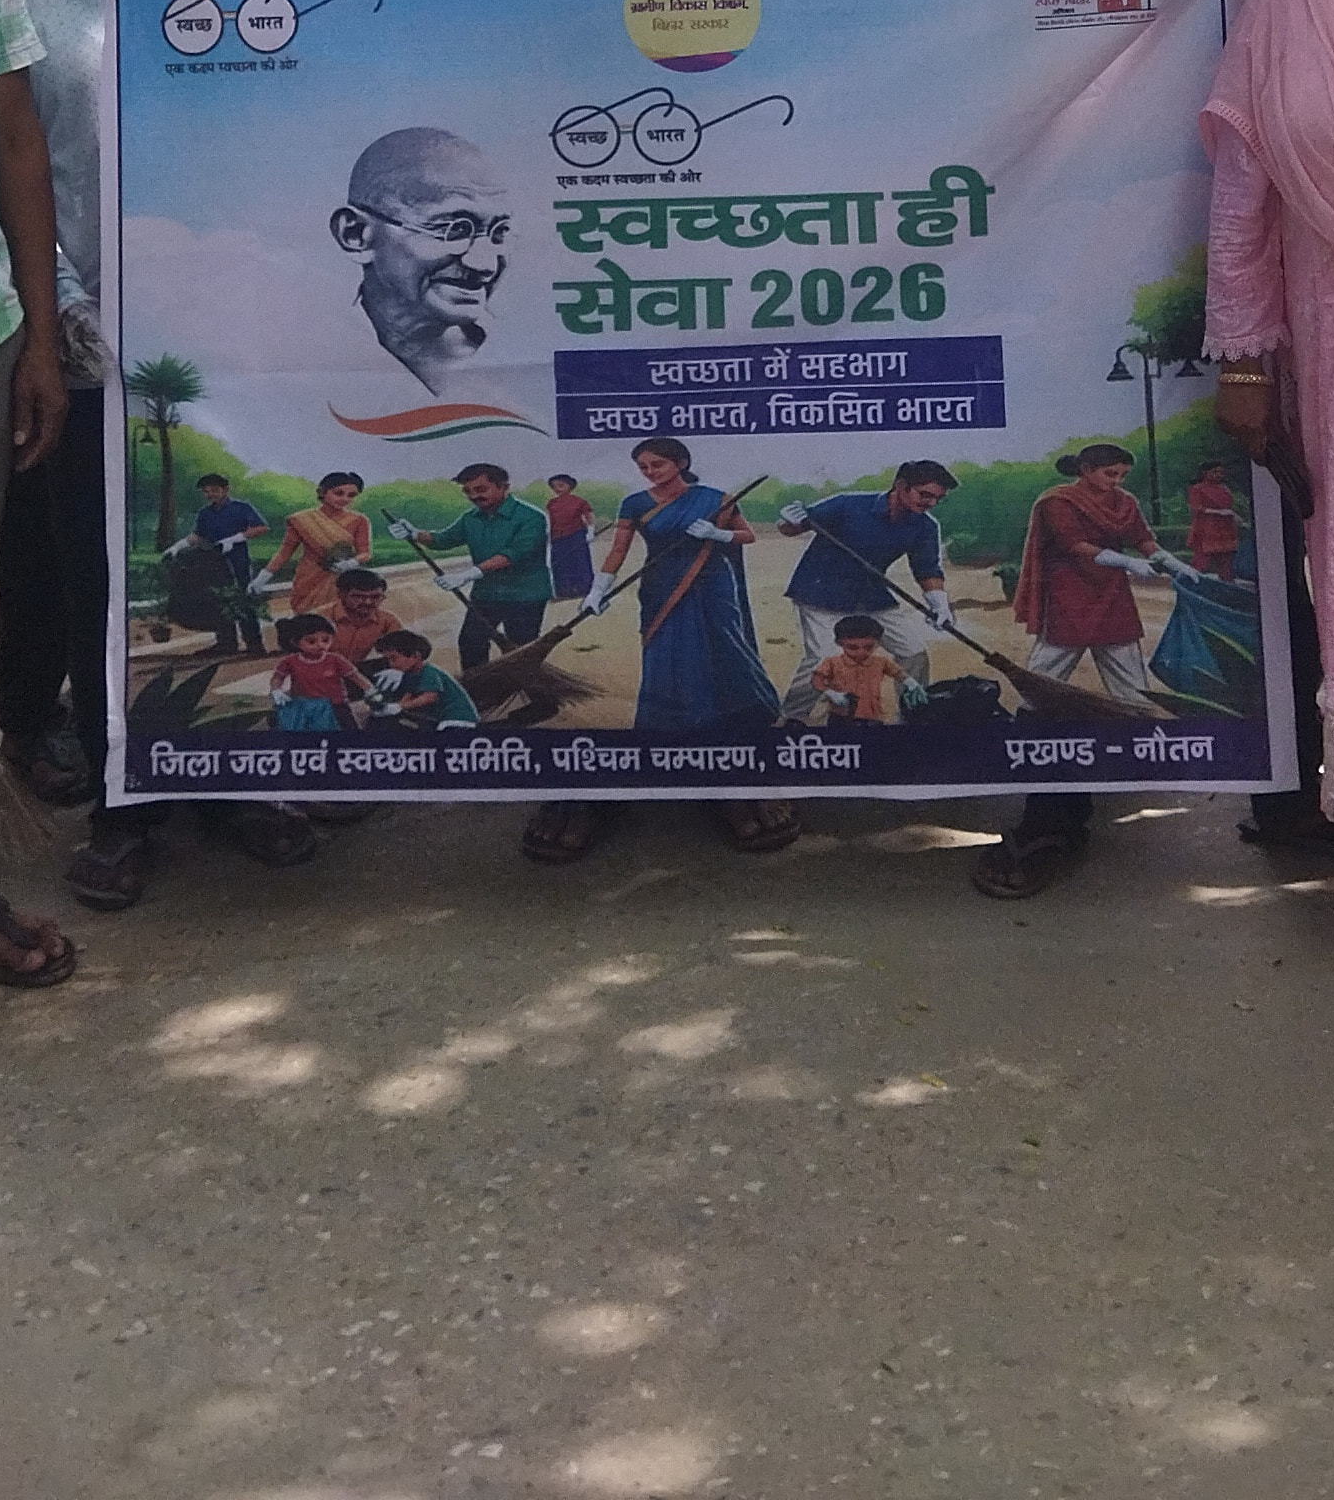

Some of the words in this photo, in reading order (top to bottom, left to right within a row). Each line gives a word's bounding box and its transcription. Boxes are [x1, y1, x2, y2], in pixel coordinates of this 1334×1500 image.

[176, 18, 213, 32] स्वच्छ
[248, 16, 283, 30] भारत
[690, 19, 729, 30] सरकार
[165, 64, 184, 77] एक
[261, 57, 276, 71] की
[279, 59, 299, 71] ओर
[567, 131, 608, 146] स्वच्छ
[646, 128, 685, 143] भारत
[556, 174, 579, 189] एक
[581, 172, 610, 186] कदम
[612, 171, 656, 185] स्वच्छता
[660, 168, 677, 184] की
[679, 168, 703, 184] ओर
[553, 191, 884, 253] स्वच्छता
[892, 164, 995, 247] ही
[552, 258, 733, 334] सेवा
[750, 262, 947, 329] 2026
[648, 356, 753, 386] स्वच्छता
[761, 347, 797, 380] में
[798, 351, 909, 380] सहभाग
[586, 404, 659, 433] स्वच्छ
[671, 402, 757, 433] भारत,
[767, 392, 884, 428] विकसित
[896, 395, 974, 423] भारत
[150, 740, 220, 777] जिला
[229, 746, 283, 776] जल
[290, 739, 328, 775] एवं
[337, 744, 437, 774] स्वच्छता
[445, 737, 541, 775] समिति,
[553, 737, 641, 773] पश्चिम
[650, 742, 765, 773] चम्पारण,
[776, 734, 862, 770] बेतिया
[1005, 736, 1096, 769] प्रखण्ड
[1132, 726, 1215, 764] नौतन
